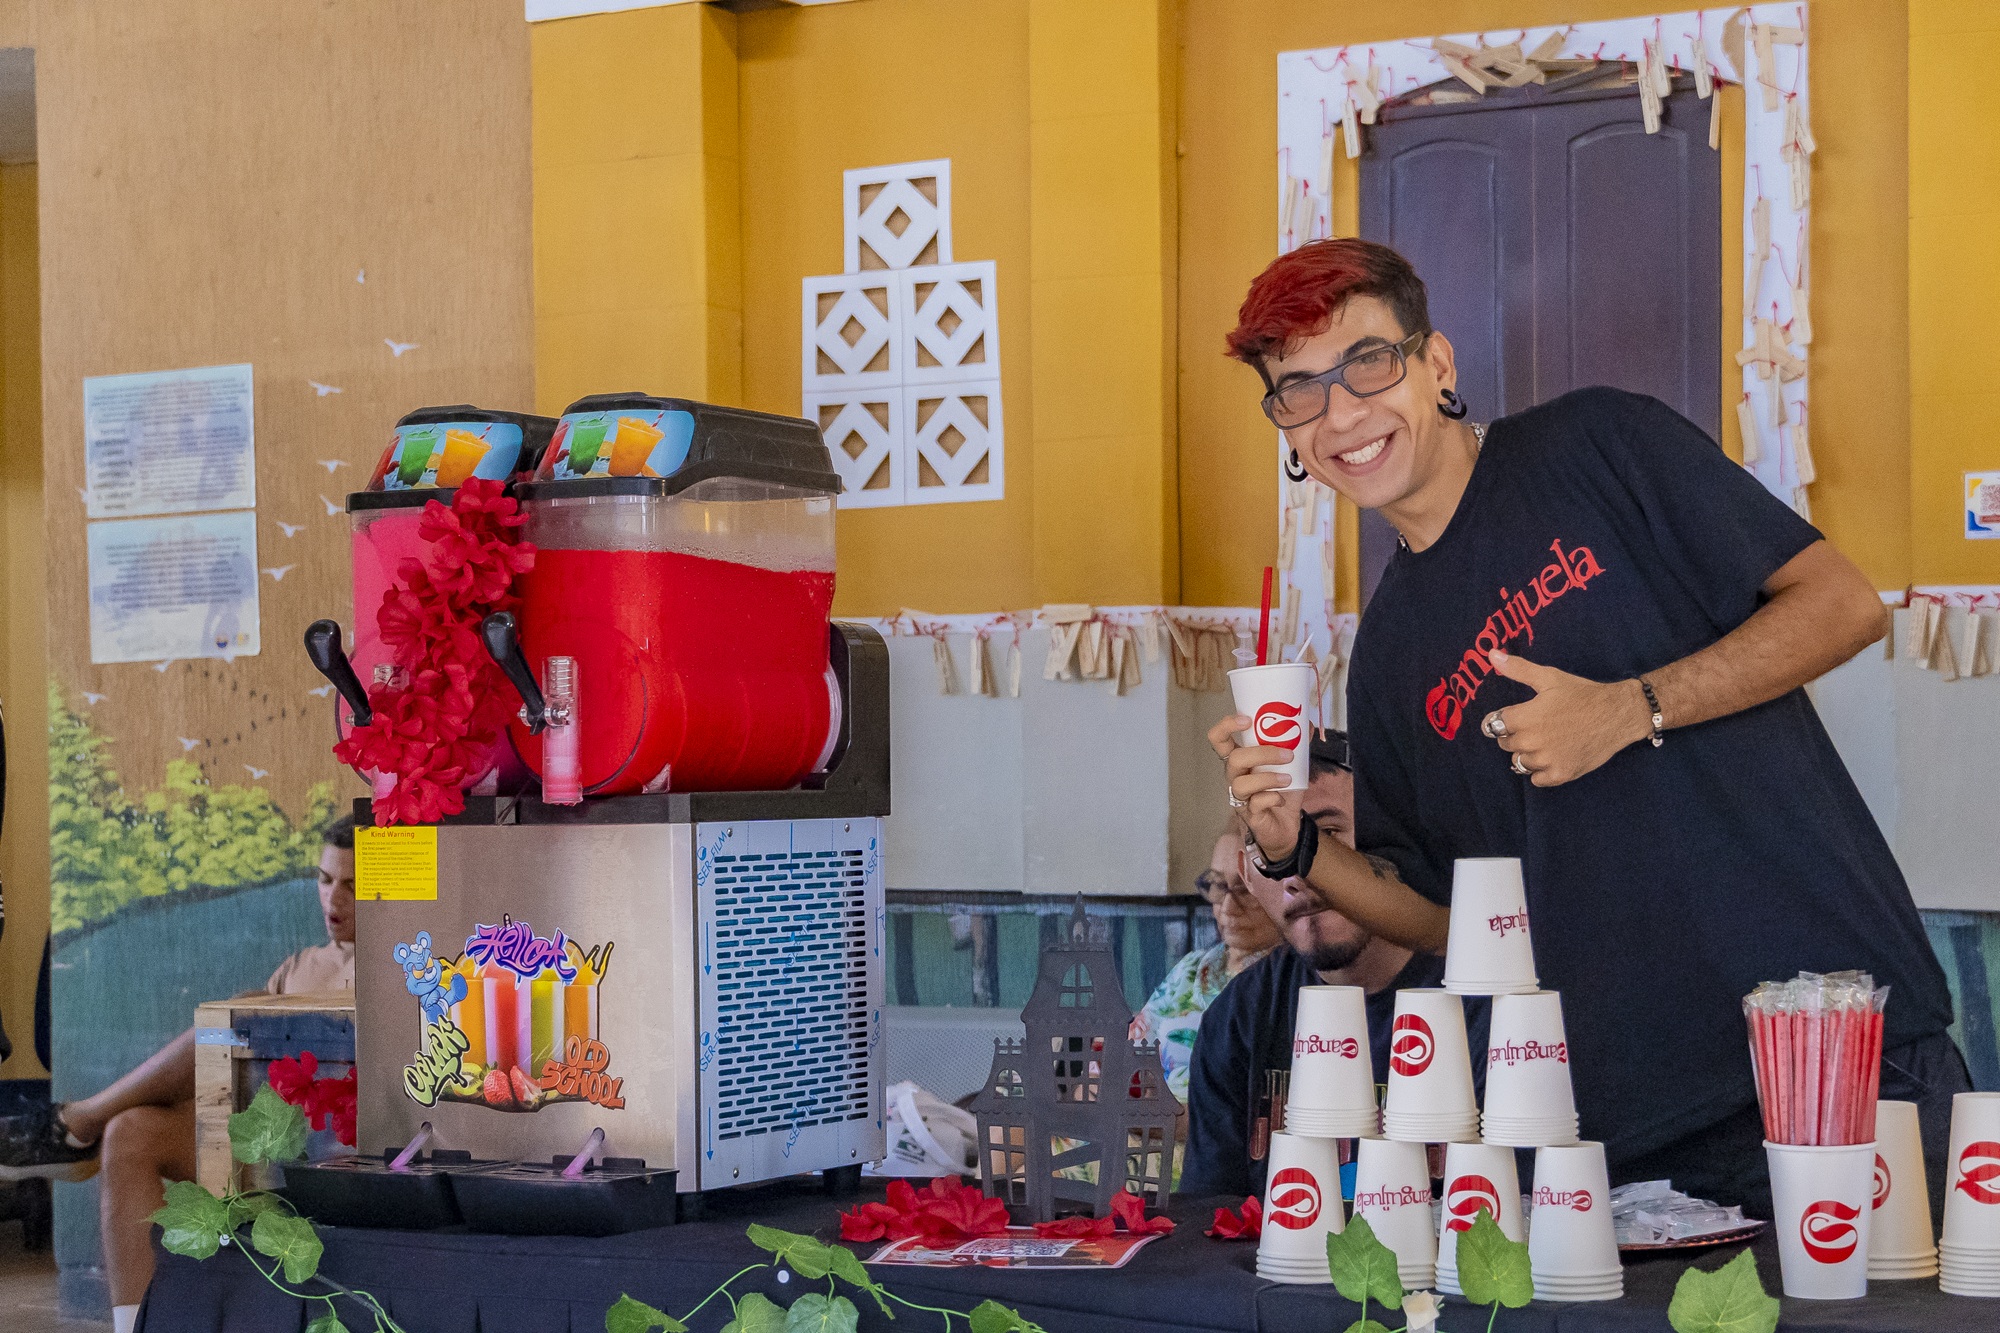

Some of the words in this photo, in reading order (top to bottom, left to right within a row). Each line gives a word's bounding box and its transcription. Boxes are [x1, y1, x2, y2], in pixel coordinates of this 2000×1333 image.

[387, 831, 415, 839] Warning
[566, 1034, 611, 1073] OLD
[540, 1059, 627, 1111] SCHOOL
